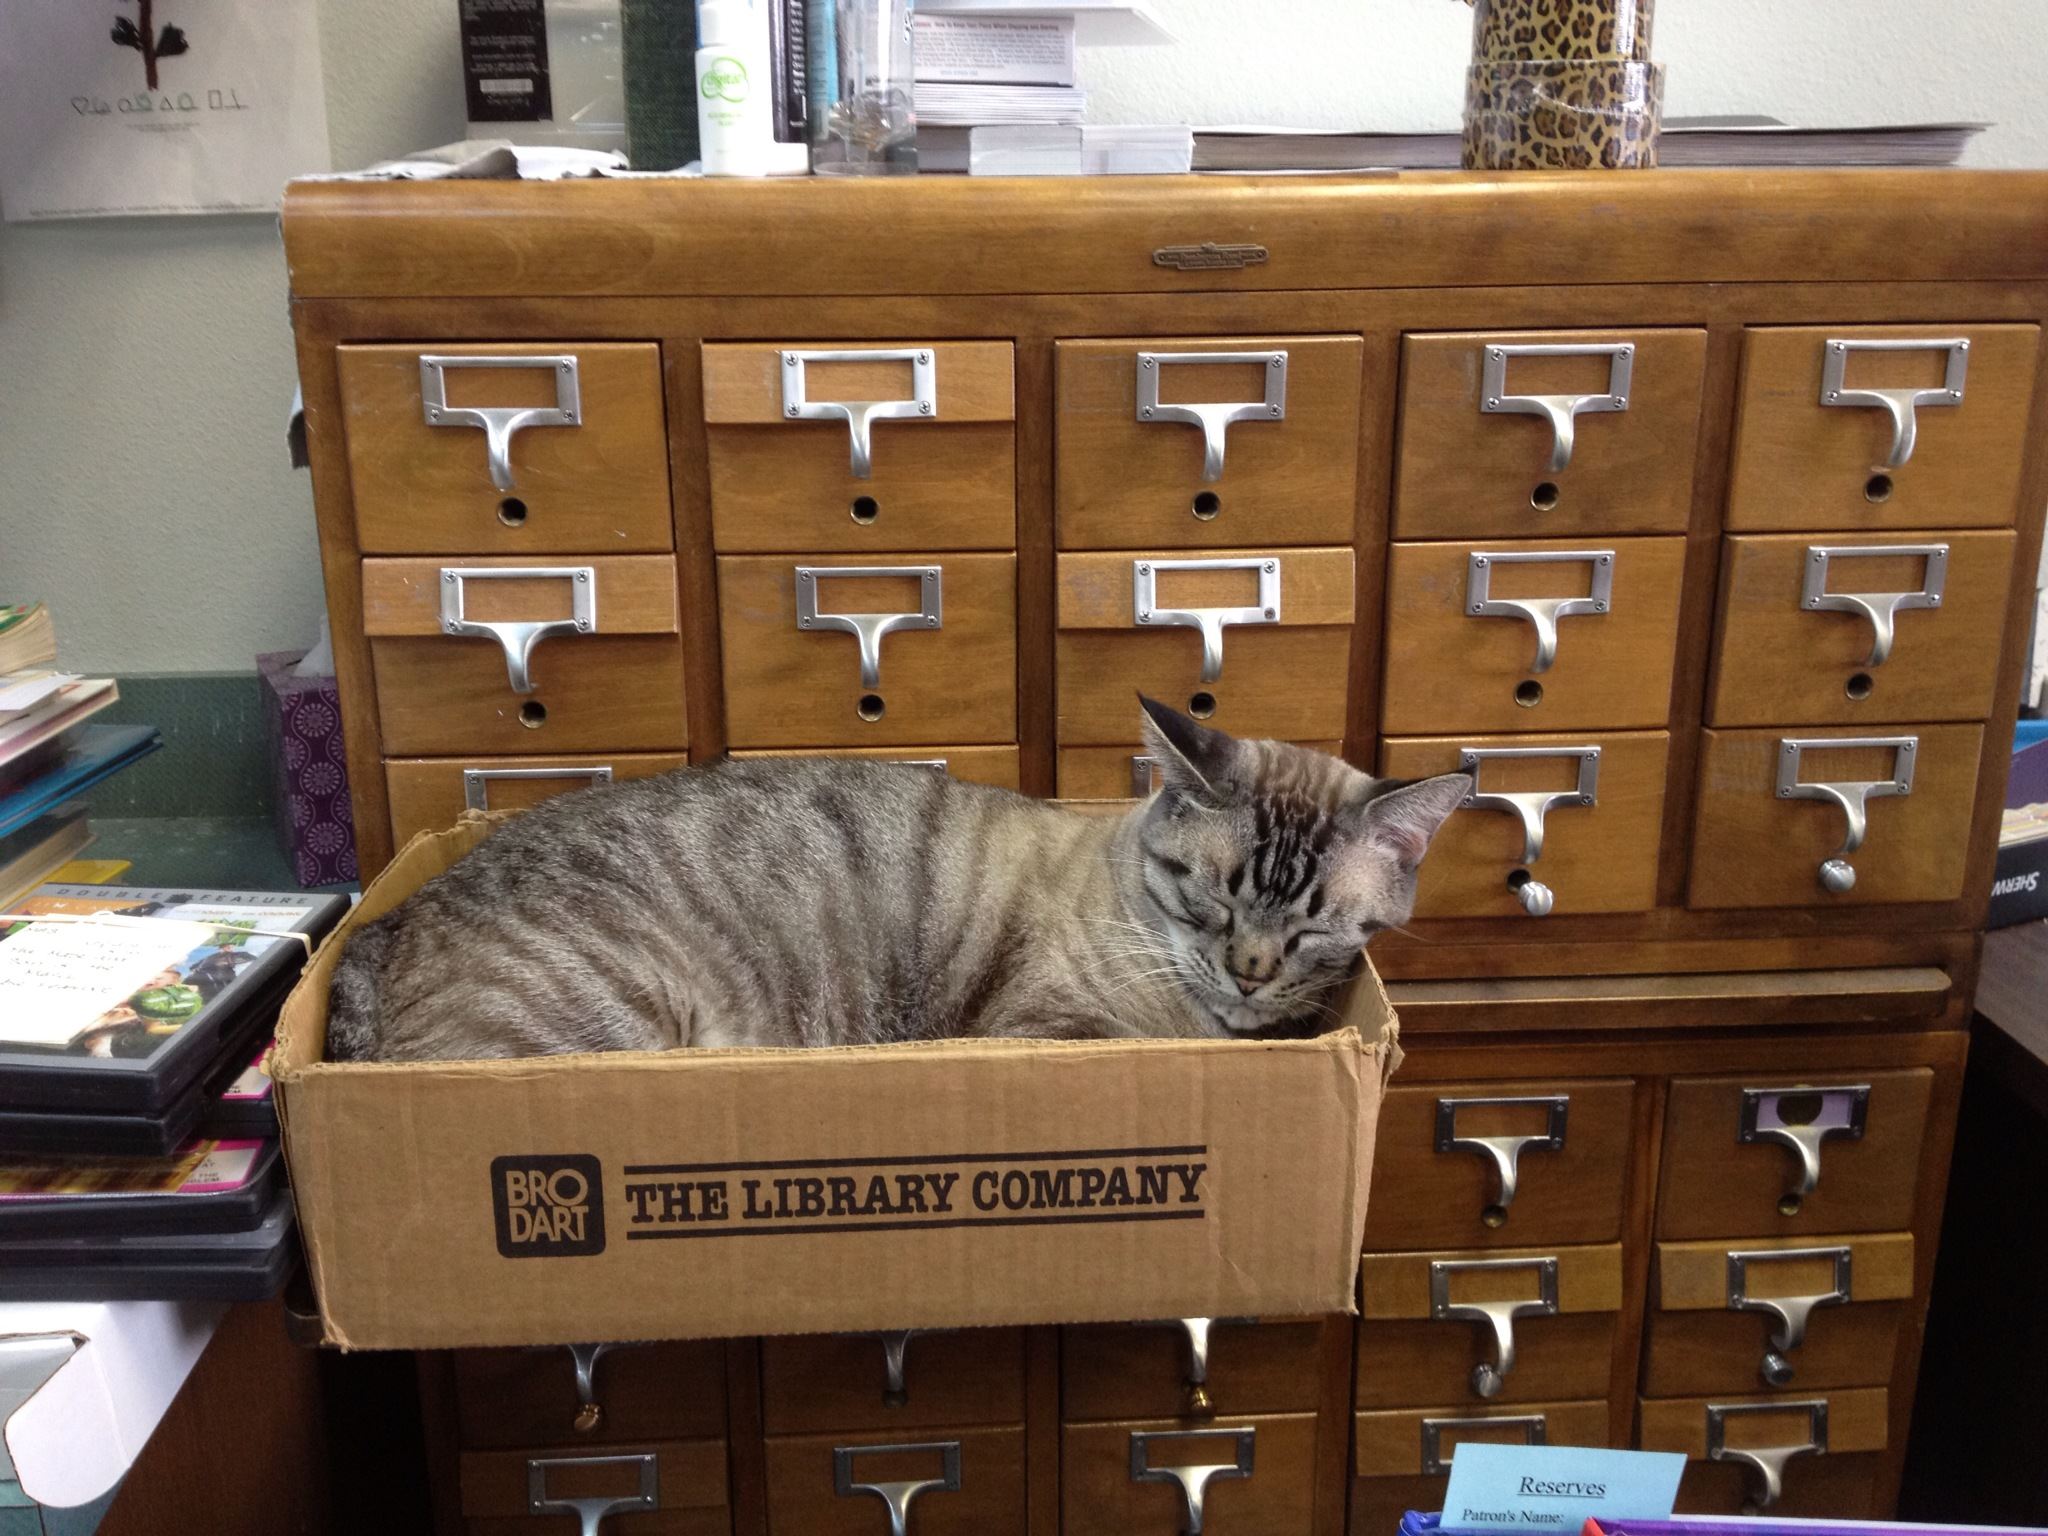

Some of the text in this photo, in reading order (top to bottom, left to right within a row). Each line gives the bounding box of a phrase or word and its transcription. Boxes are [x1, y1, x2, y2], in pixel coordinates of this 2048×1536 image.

[56, 888, 308, 905] DOUBLE FEATURE
[505, 1168, 588, 1207] BRO
[625, 1163, 1207, 1224] THE LIBRARY COMPANY
[508, 1205, 589, 1244] DART
[1519, 1476, 1607, 1497] Reserves
[1462, 1508, 1565, 1524] Patron's Name:
